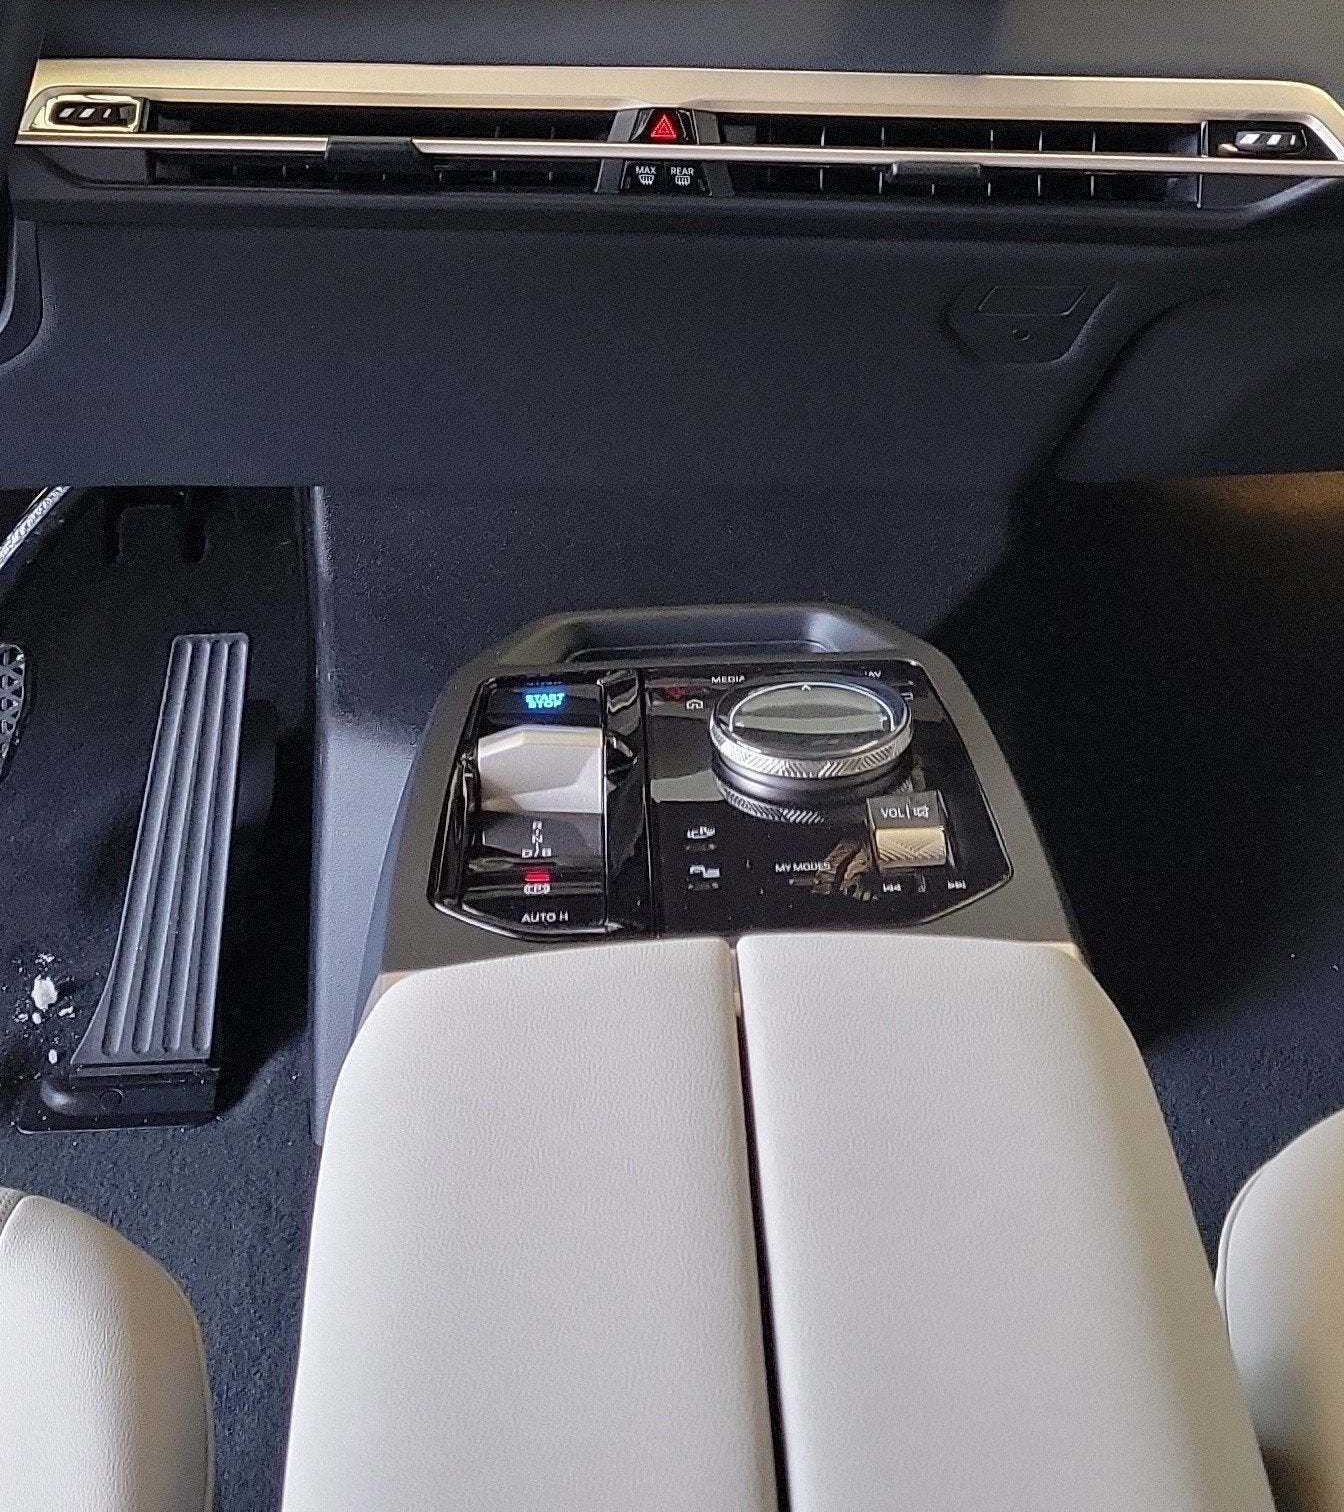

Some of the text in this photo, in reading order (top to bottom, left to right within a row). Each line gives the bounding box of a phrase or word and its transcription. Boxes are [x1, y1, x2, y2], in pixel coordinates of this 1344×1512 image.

[635, 165, 657, 175] MAX
[670, 166, 695, 176] REAR
[880, 806, 905, 819] VOL
[521, 910, 569, 923] AUTO H
